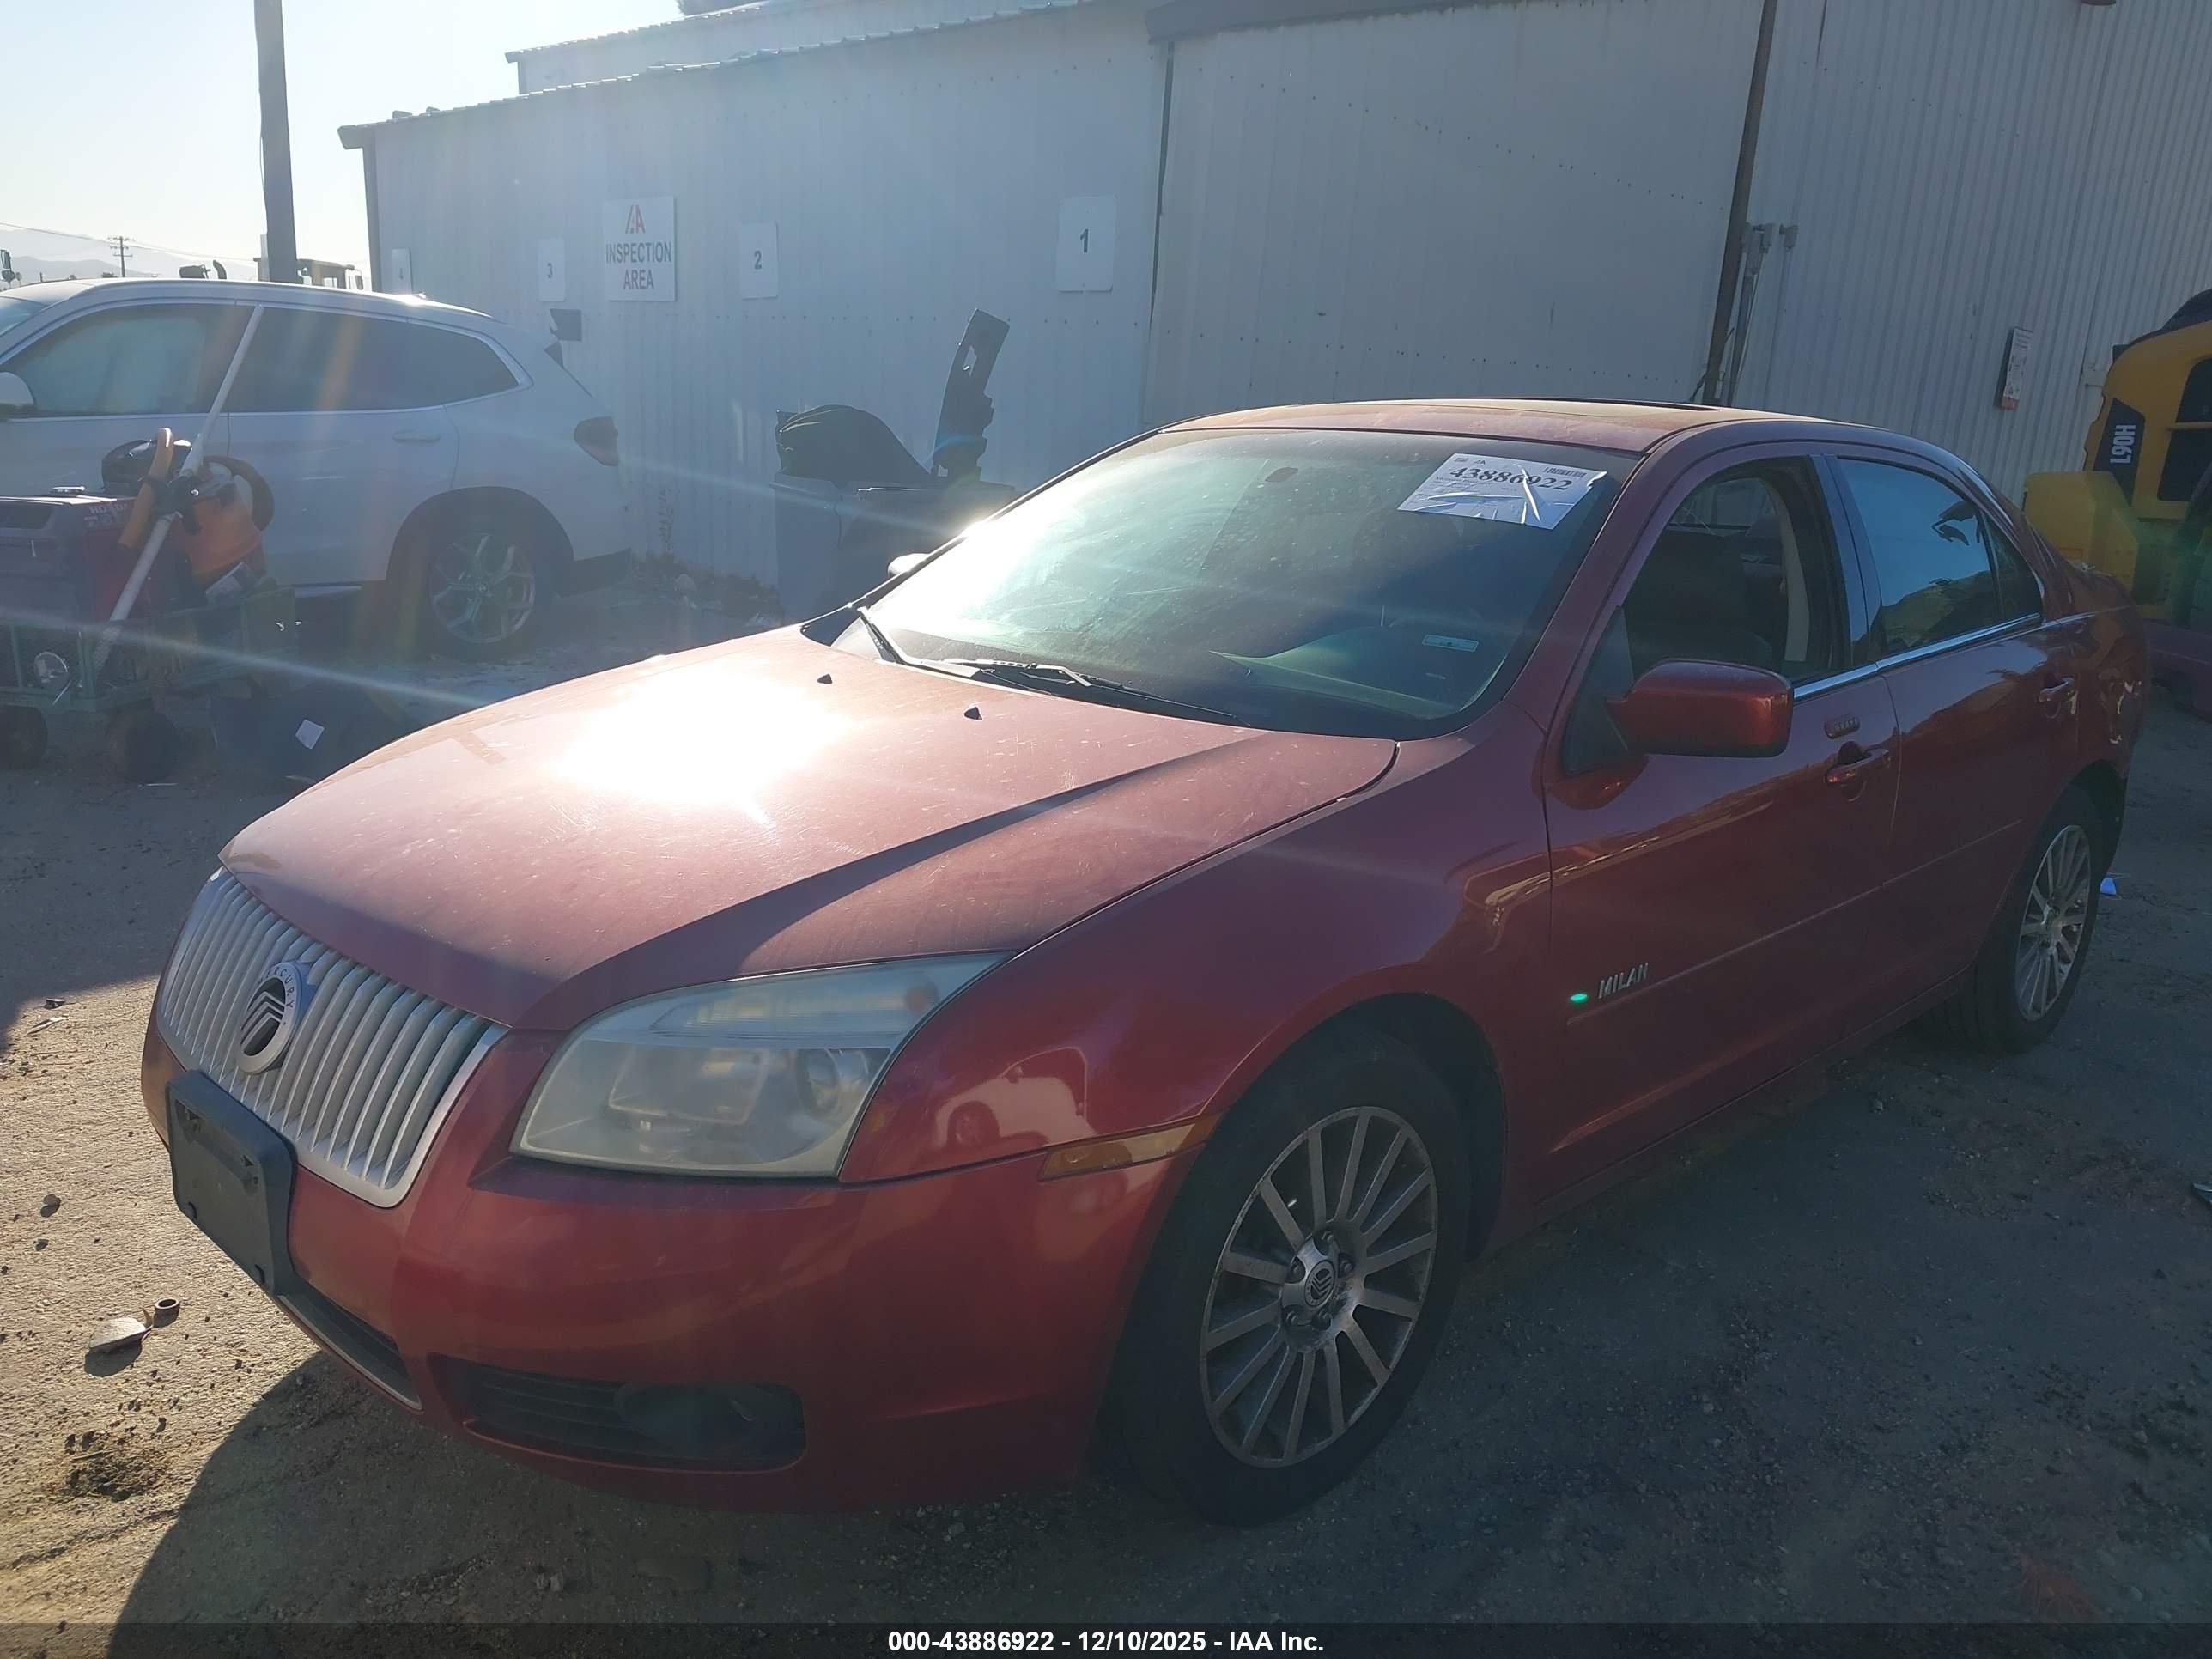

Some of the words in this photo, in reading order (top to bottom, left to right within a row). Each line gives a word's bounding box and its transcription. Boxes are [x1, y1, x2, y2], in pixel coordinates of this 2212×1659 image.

[605, 241, 672, 264] INSPECTION
[1079, 228, 1090, 254] 1
[546, 261, 555, 280] 3
[753, 249, 763, 270] 2
[623, 269, 655, 289] AREA
[2109, 424, 2137, 464] L90H
[1449, 466, 1572, 490] 43886922
[1598, 962, 1650, 1000] MILAN
